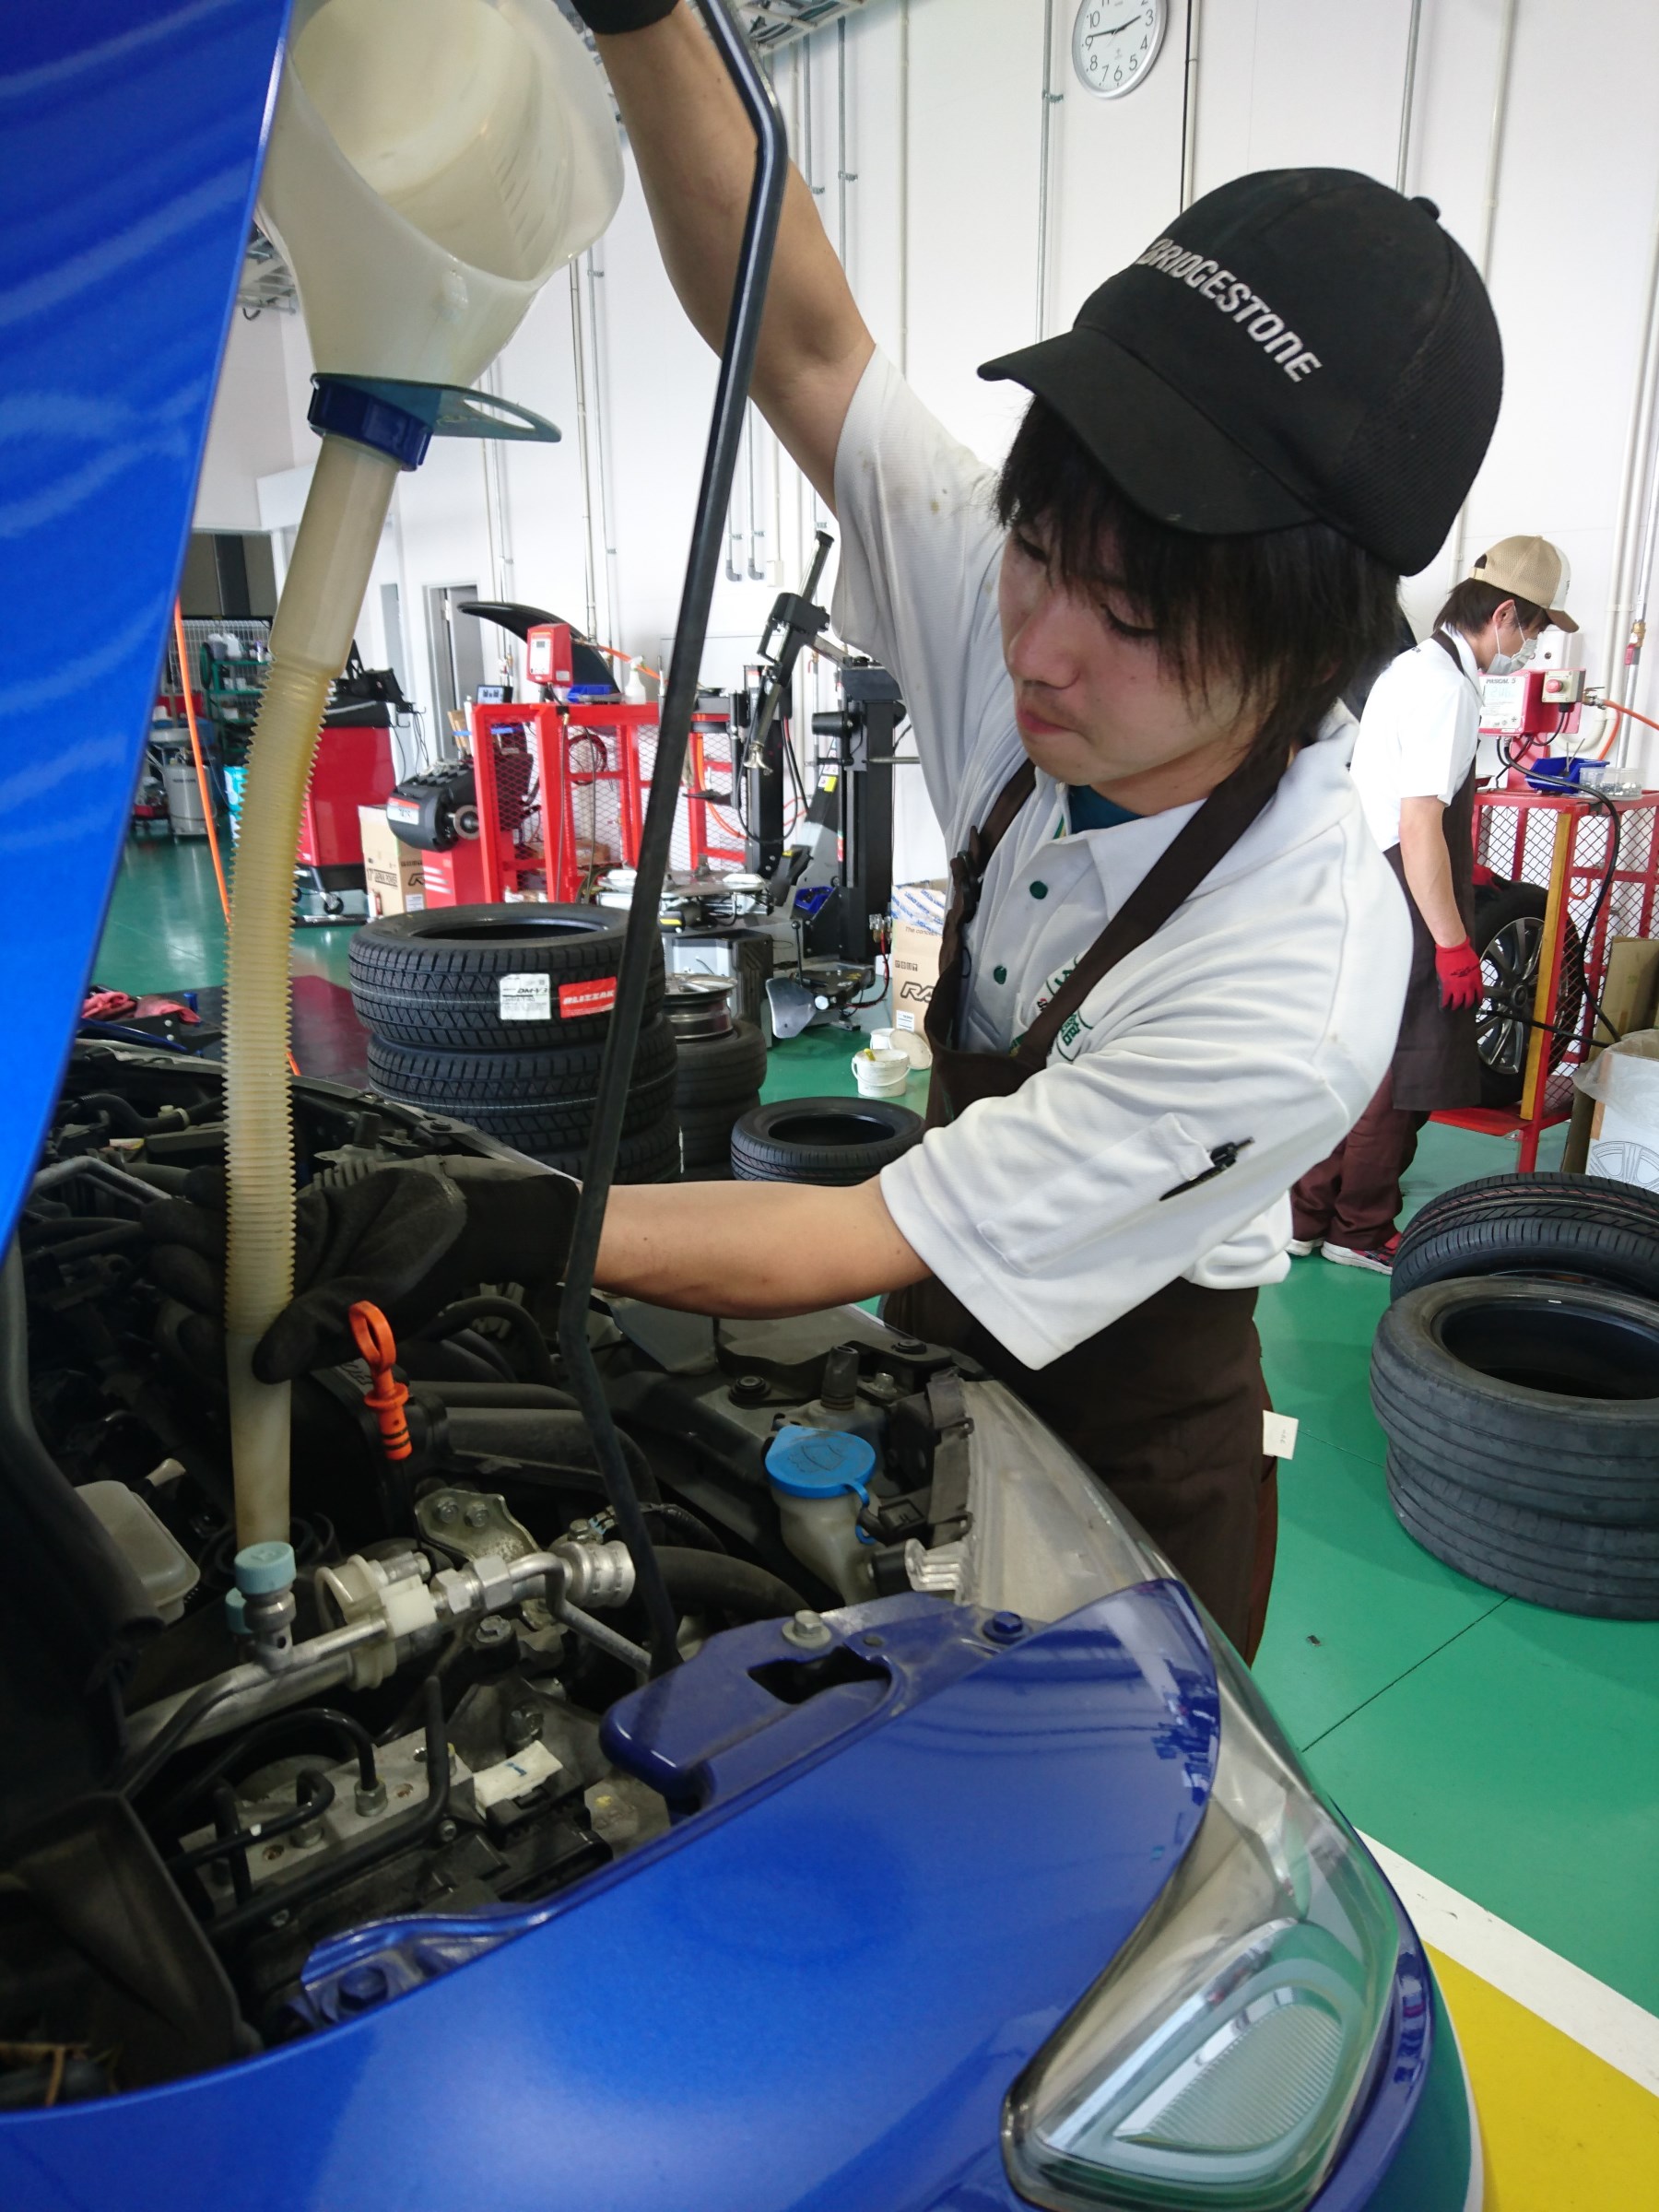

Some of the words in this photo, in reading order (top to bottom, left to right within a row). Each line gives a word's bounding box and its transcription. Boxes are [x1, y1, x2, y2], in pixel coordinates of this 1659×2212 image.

[1088, 10, 1100, 29] 10
[1145, 8, 1154, 27] 3
[1085, 36, 1094, 51] 9
[1140, 34, 1148, 50] 4
[1089, 54, 1099, 71] 8
[1129, 53, 1138, 71] 5
[1101, 64, 1110, 82] 7
[1113, 65, 1123, 82] 6
[1135, 238, 1324, 383] BRIDGESTONE
